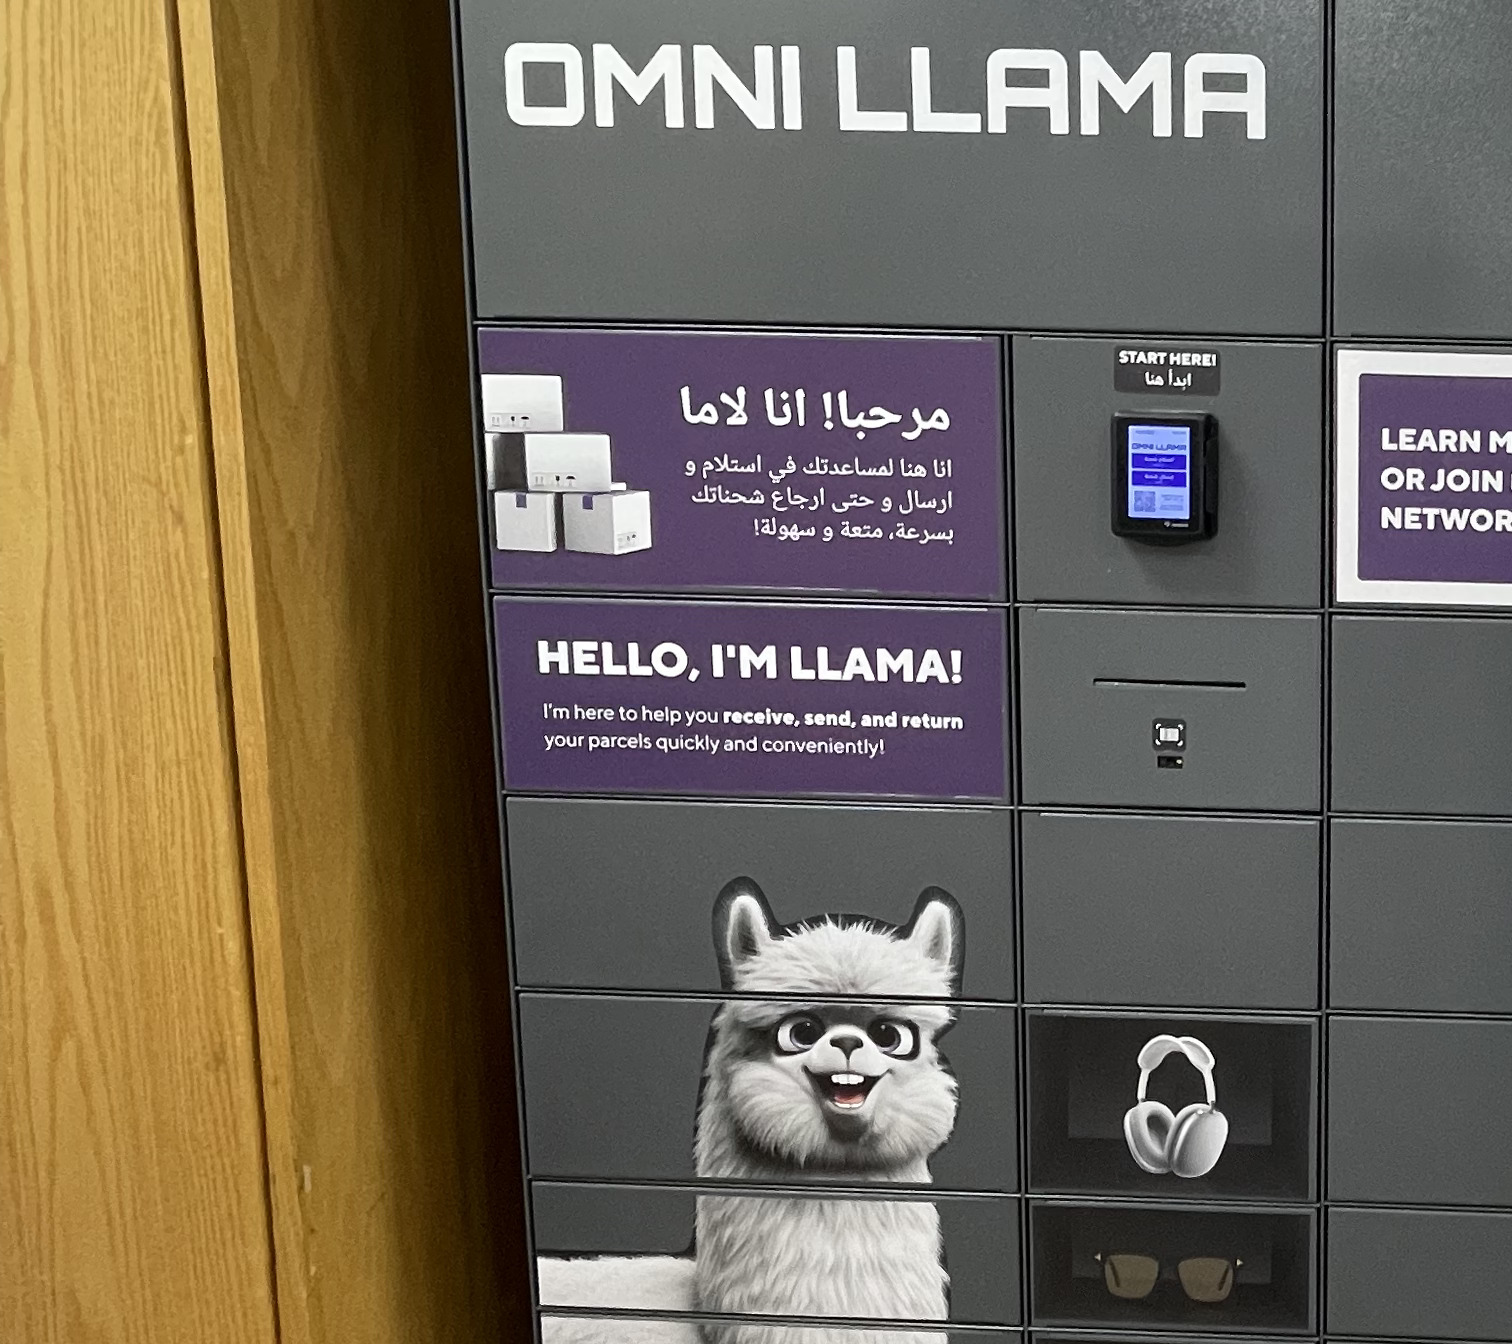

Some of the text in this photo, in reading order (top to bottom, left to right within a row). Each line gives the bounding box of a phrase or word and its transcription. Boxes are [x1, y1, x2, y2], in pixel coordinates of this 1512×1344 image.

[504, 42, 1267, 140] OMNI LLAMA
[1119, 350, 1217, 367] START HERE!
[1144, 369, 1192, 390] ابدأ هنا
[680, 385, 950, 441] مرحبا! انا لاما
[1381, 427, 1481, 453] LEARN
[684, 453, 952, 484] انا هنا لمساعدتك في استلام و
[1380, 466, 1426, 491] OR
[1429, 468, 1504, 493] JOIN
[691, 484, 953, 515] ارسال و حتى ارجاع شحناتك
[753, 516, 816, 541] سهولة!
[822, 526, 834, 542] و
[840, 520, 884, 539] متعة
[537, 640, 962, 684] HELLO, I'M LLAMA!
[543, 702, 964, 730] I'm here to help you receive, send, and return
[543, 732, 885, 759] your parcels quickly and conveniently!
